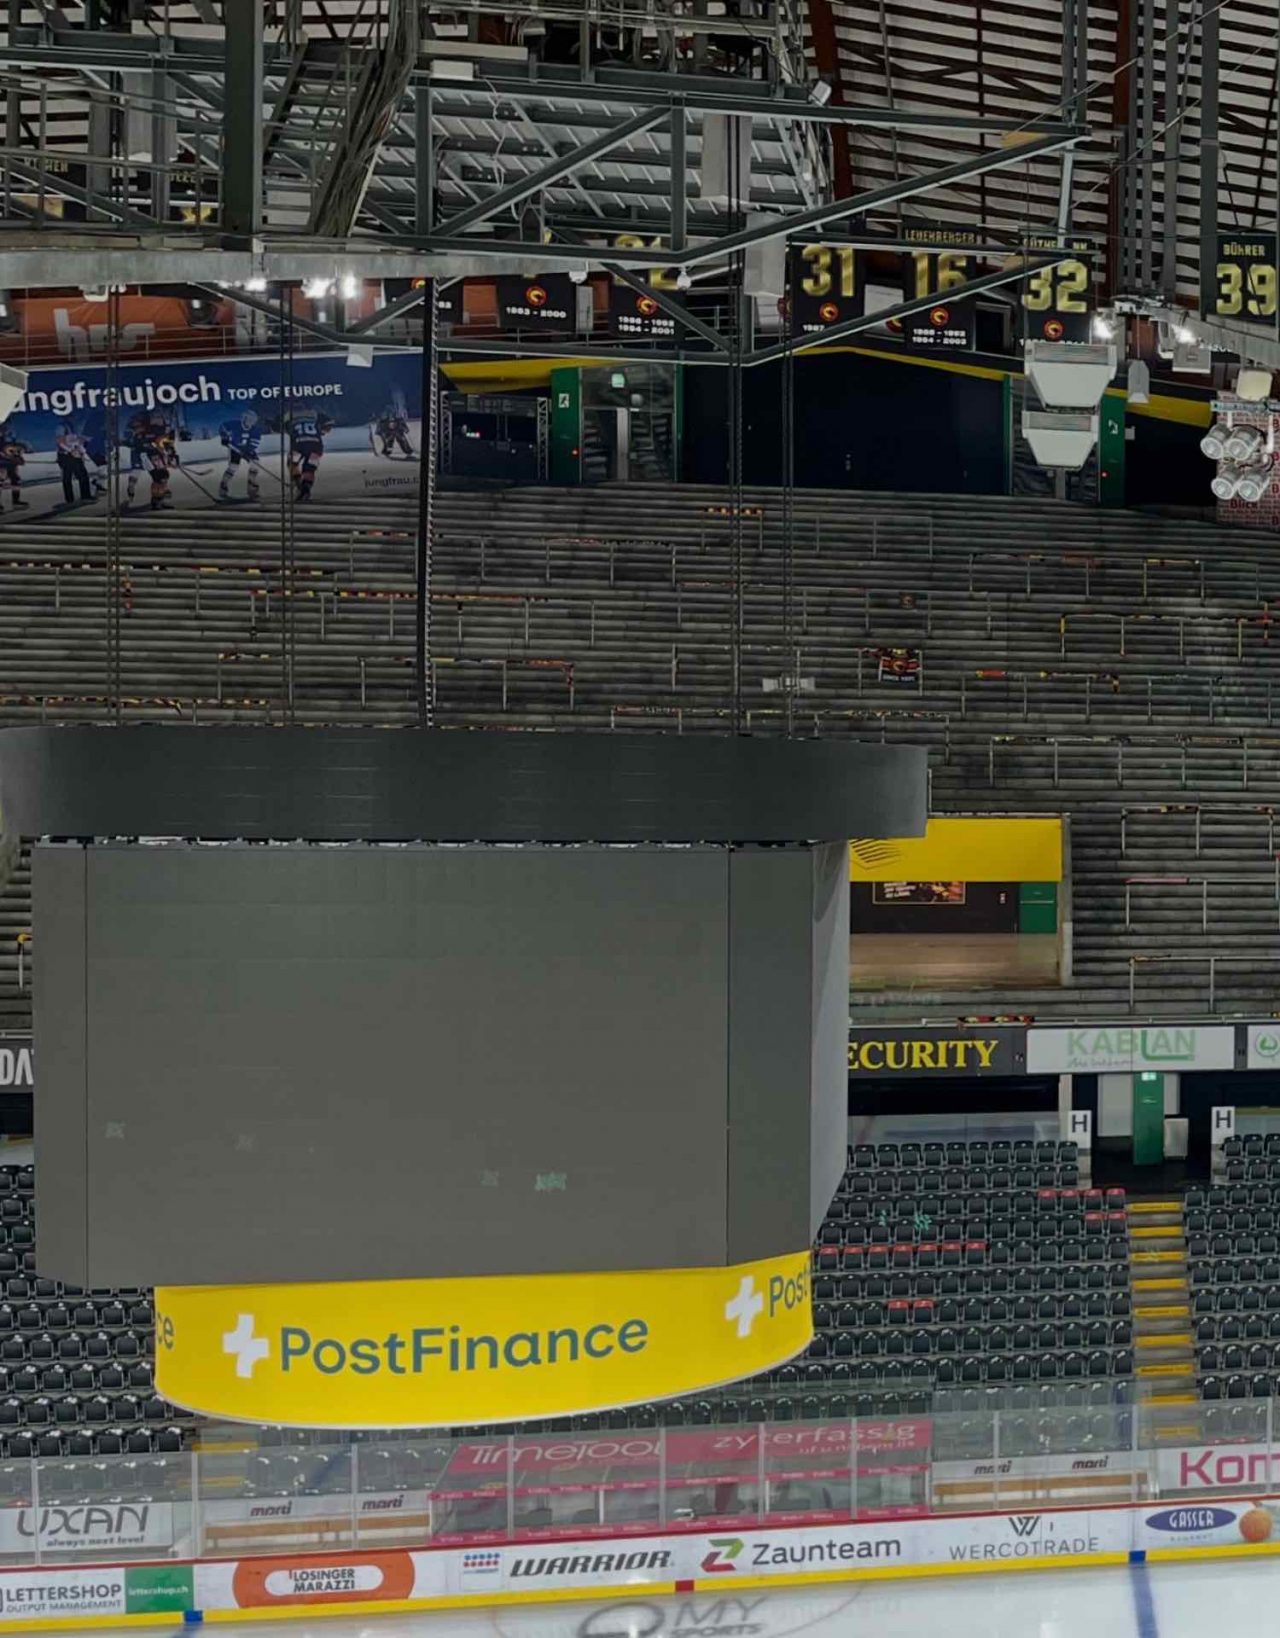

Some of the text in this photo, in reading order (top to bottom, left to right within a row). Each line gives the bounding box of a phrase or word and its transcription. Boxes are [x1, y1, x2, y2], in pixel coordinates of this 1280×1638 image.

[802, 245, 855, 297] 31
[911, 249, 967, 299] 16
[1023, 259, 1088, 313] 32
[1216, 263, 1277, 316] 39
[12, 375, 343, 416] ungfraujoch TOP OF EUROPE
[847, 1040, 999, 1070] ECURITY
[1067, 1029, 1196, 1061] KABLAN
[1072, 1115, 1087, 1132] H
[1216, 1111, 1232, 1128] H
[281, 1318, 648, 1374] PostFinance
[974, 1460, 1012, 1475] mati
[1071, 1456, 1109, 1470] marti
[362, 1495, 404, 1510] marti
[17, 1505, 149, 1537] UXAN
[1169, 1510, 1214, 1528] GASSER
[752, 1537, 901, 1566] Zaunteam
[950, 1537, 1099, 1560] WERCOTRADE
[293, 1568, 355, 1582] LOSINGER
[510, 1551, 671, 1577] WARRIOR
[7, 1584, 122, 1602] LETTERSHOP
[294, 1580, 355, 1593] MARAZZI
